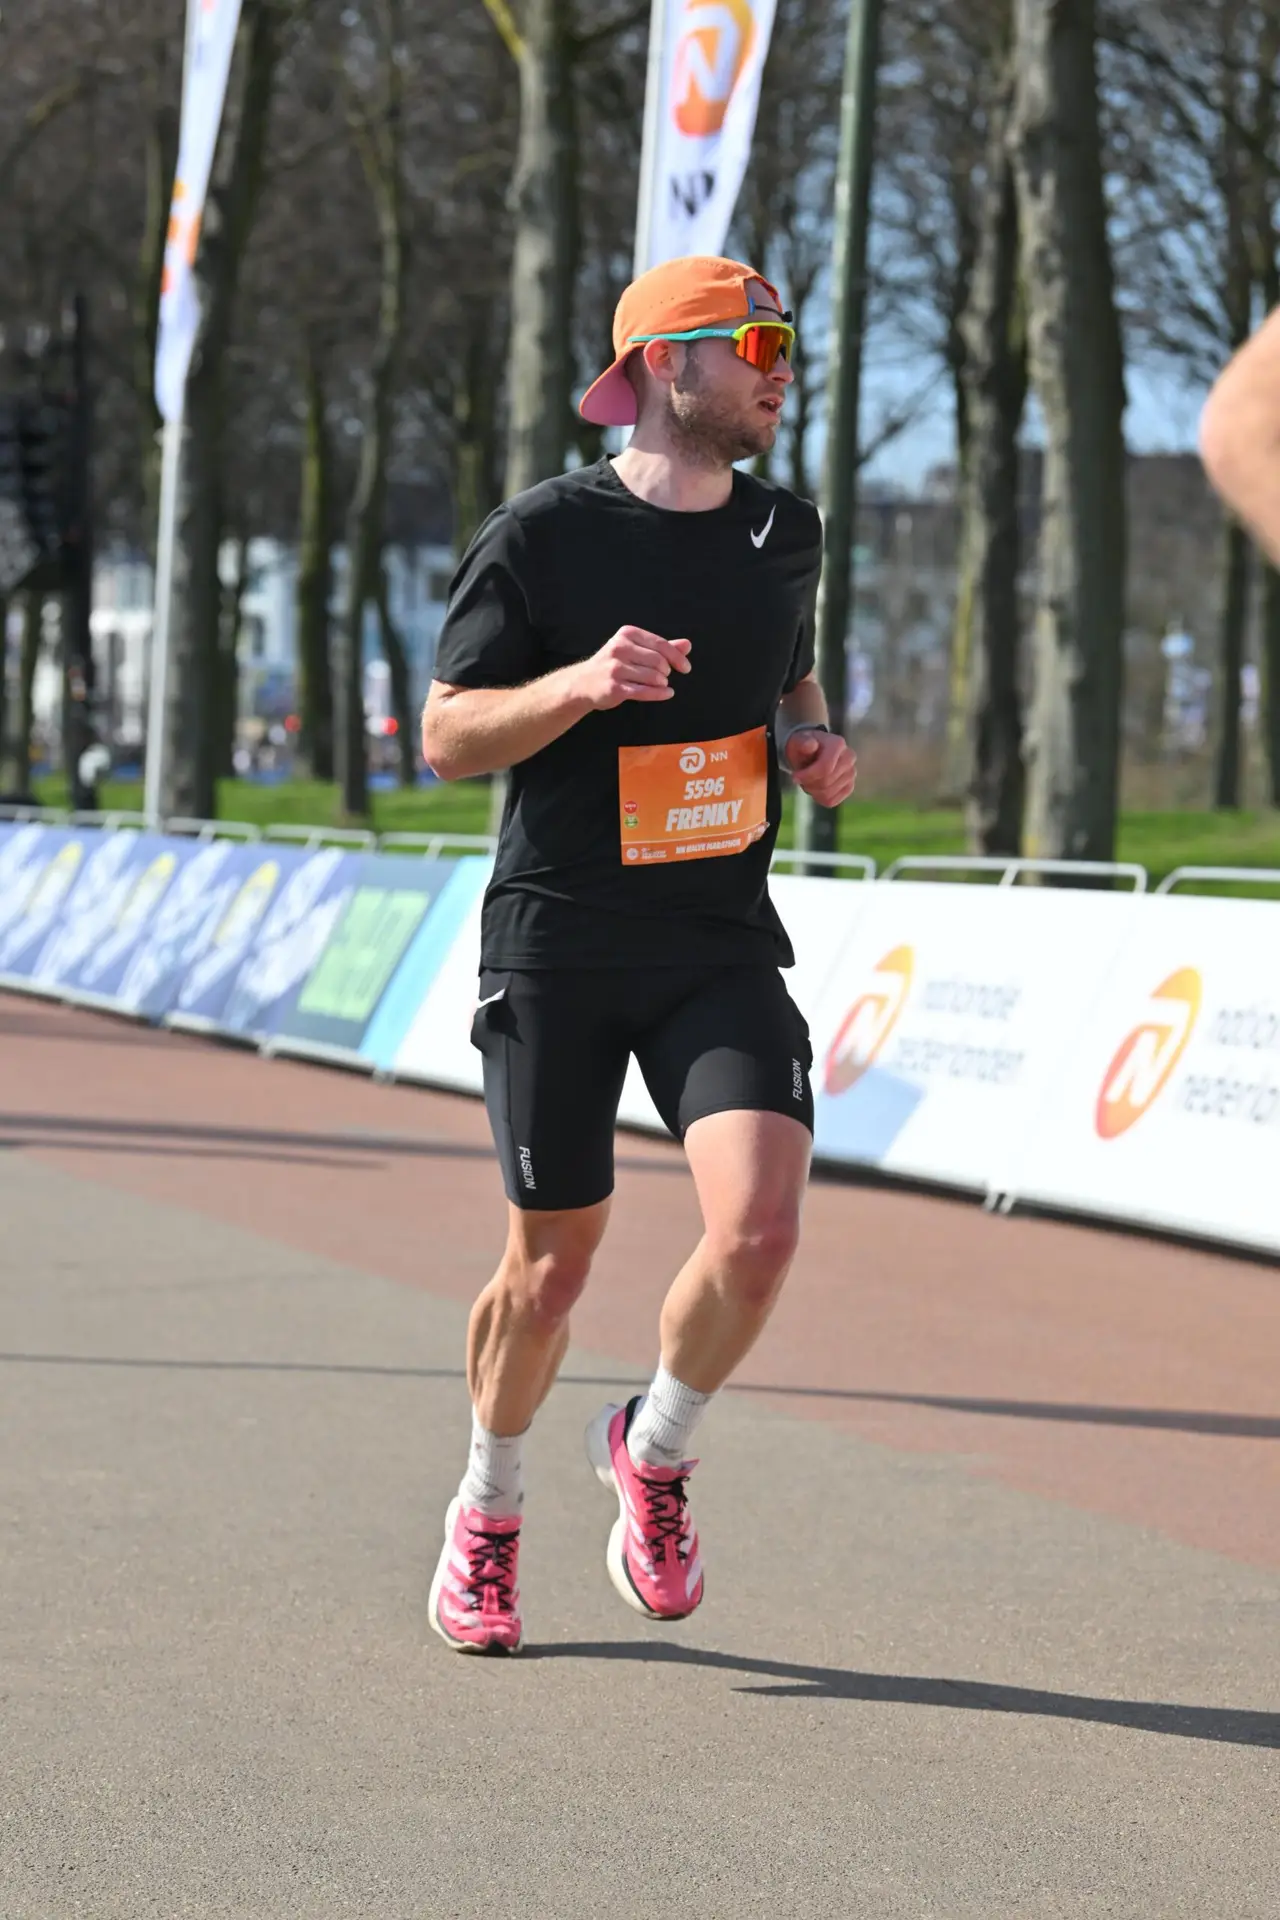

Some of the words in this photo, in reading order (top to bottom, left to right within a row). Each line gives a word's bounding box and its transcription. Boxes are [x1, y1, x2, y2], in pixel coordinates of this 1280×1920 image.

[710, 750, 728, 763] NN
[683, 776, 725, 800] 5596
[665, 799, 743, 832] FRENKY
[792, 1058, 803, 1101] FUSION
[519, 1146, 537, 1190] FUSION
